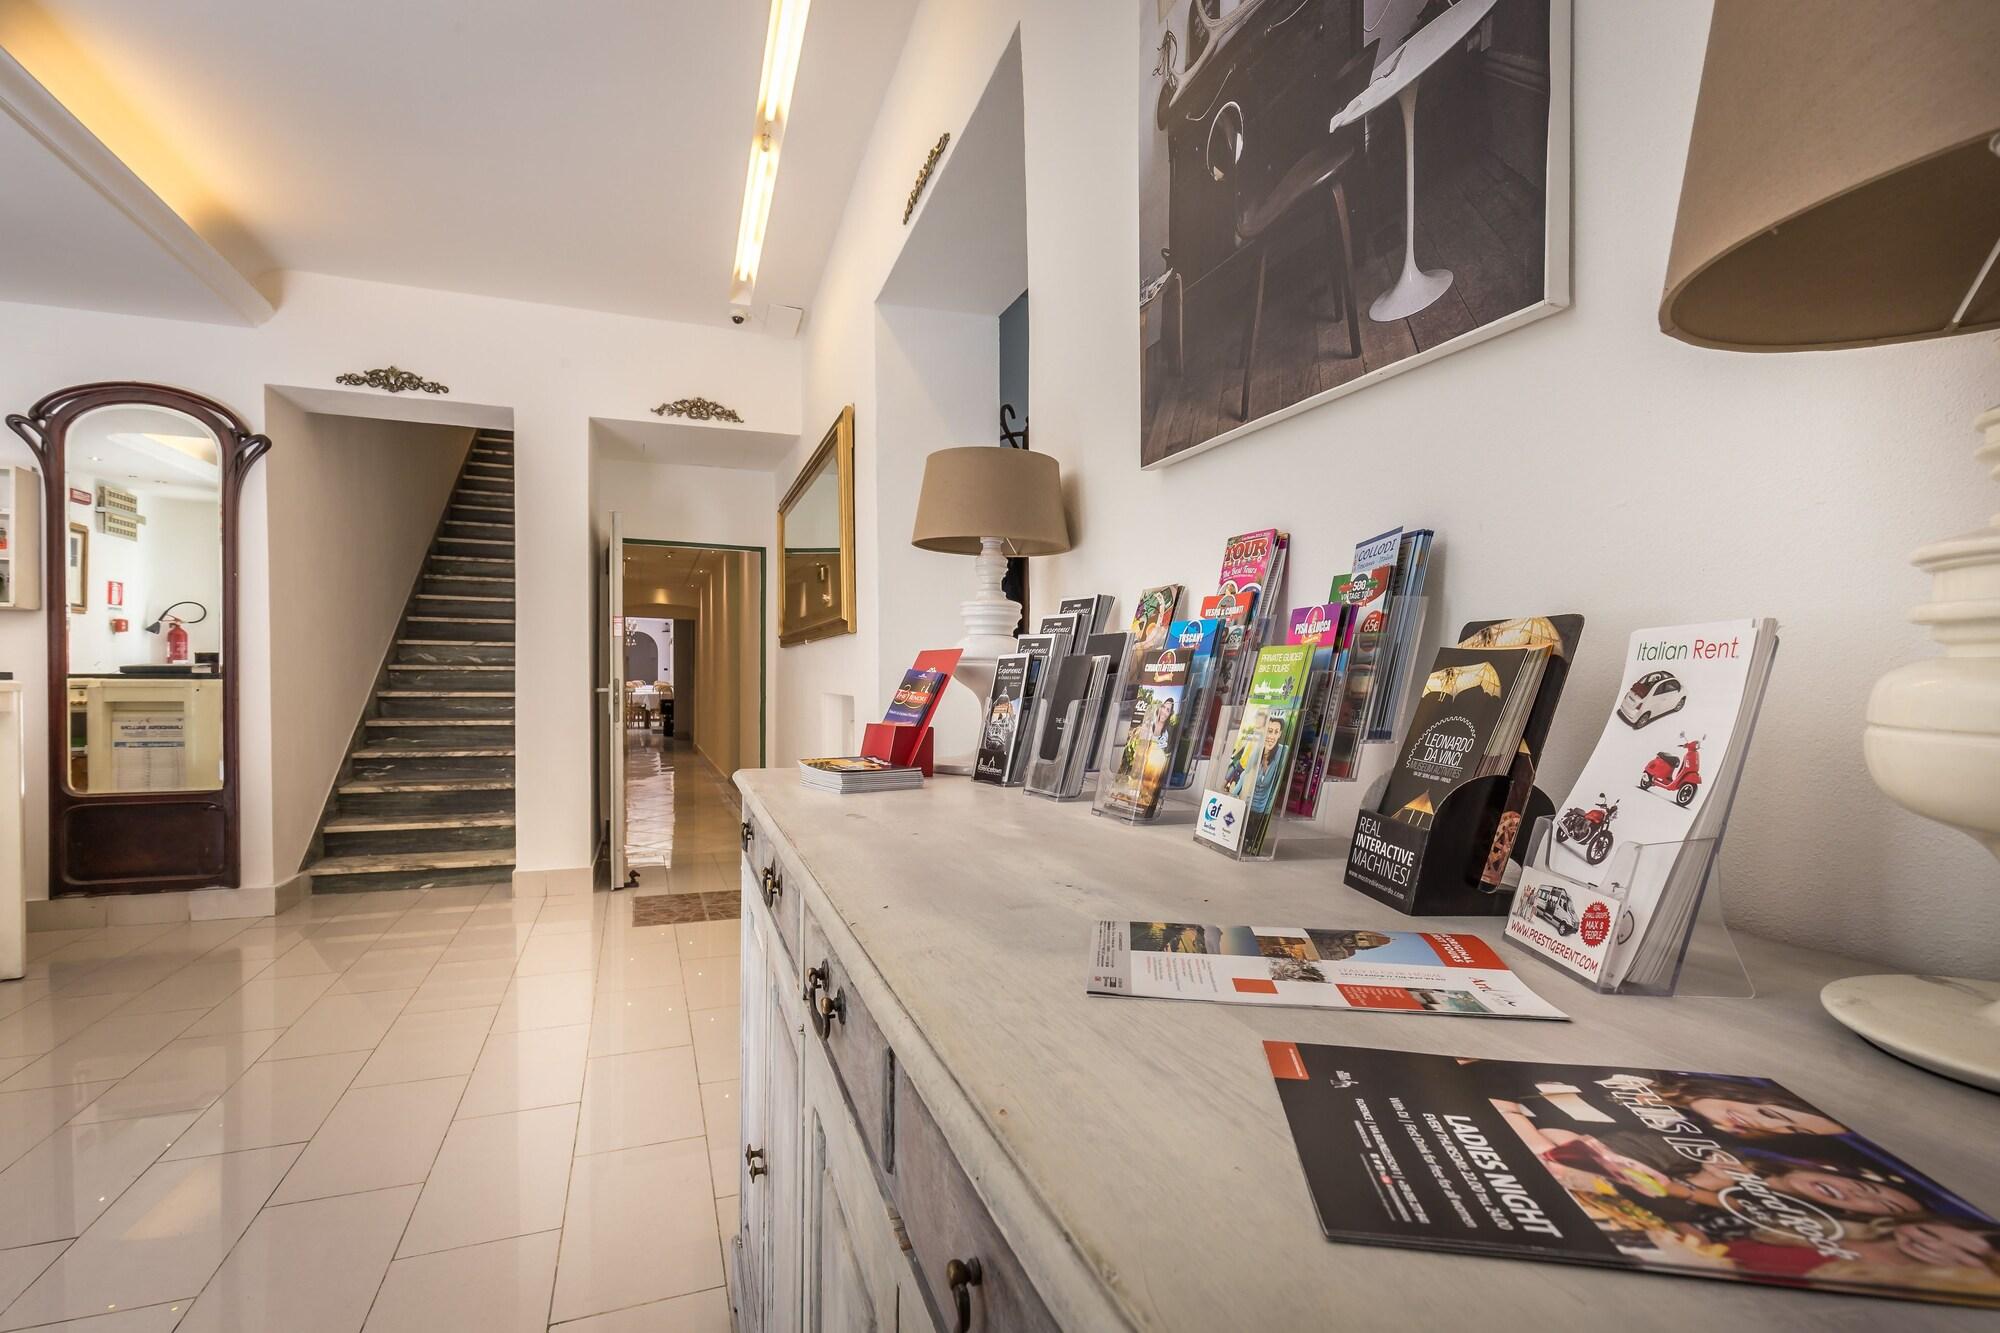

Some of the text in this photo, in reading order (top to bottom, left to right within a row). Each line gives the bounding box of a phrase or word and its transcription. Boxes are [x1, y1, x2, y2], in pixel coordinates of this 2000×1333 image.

[1225, 538, 1268, 561] TOUR
[1358, 539, 1397, 561] COLLODI
[1353, 580, 1367, 591] 500
[1361, 589, 1374, 599] TOUR
[1295, 622, 1308, 635] PISA
[1313, 620, 1331, 633] LUCCA
[1364, 619, 1379, 632] 65€
[1179, 632, 1204, 644] TUSCANY
[1262, 653, 1282, 662] PRIVATE
[1637, 636, 1737, 661] Italian Rent
[1272, 664, 1290, 672] TOURS
[1424, 732, 1475, 753] LEONARDO
[1423, 747, 1463, 767] DA VINCI
[1359, 816, 1381, 838] REAL
[1355, 833, 1415, 867] INTERACTIVE
[1351, 848, 1411, 886] MACHINES!
[1585, 921, 1598, 929] MAX
[1585, 930, 1602, 940] PEOPLE
[1511, 920, 1599, 974] WWW.PRESTIGERENT.COM
[1355, 1098, 1374, 1121] FLORENCE
[1389, 1097, 1405, 1112] With
[1593, 1074, 1742, 1163] THIS IS
[1411, 1136, 1433, 1155] Drink
[1421, 1153, 1438, 1165] for
[1422, 1113, 1447, 1134] EVERY
[1460, 1171, 1486, 1193] 22.00
[1483, 1204, 1514, 1231] 24.00
[1443, 1114, 1564, 1239] LADIES NIGHT
[1438, 1177, 1452, 1190] for
[1443, 1190, 1461, 1200] all
[1450, 1199, 1478, 1229] women
[1722, 1169, 1862, 1260] Hard Rock
